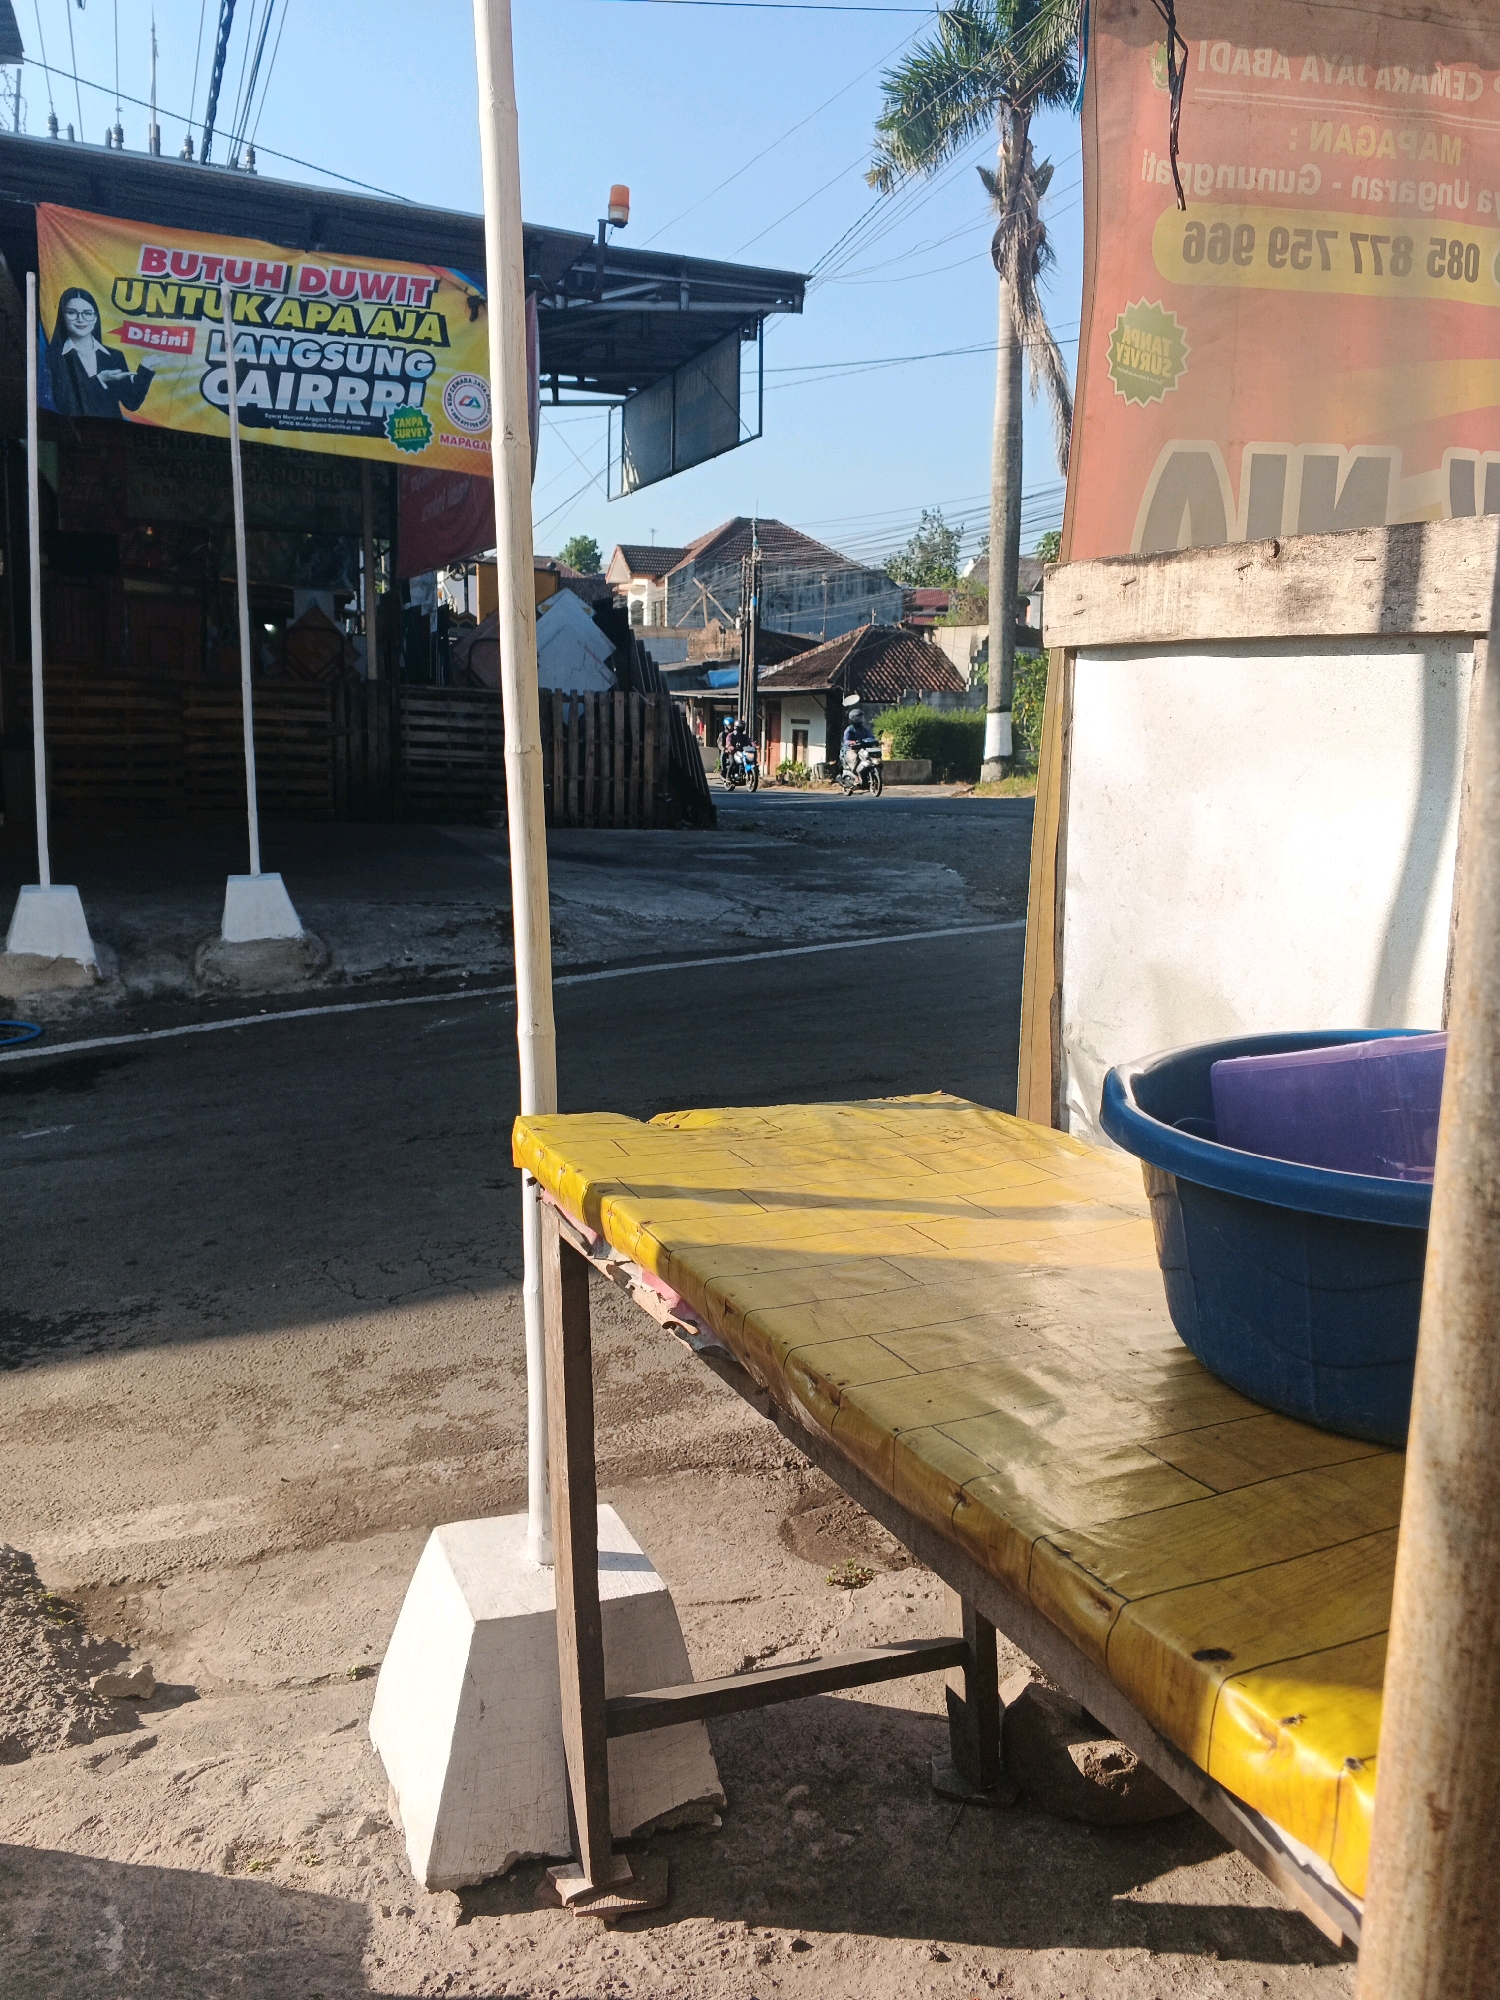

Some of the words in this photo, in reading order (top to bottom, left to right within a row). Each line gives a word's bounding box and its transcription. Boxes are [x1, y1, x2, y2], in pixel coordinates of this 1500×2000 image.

[139, 246, 286, 290] BUTUH
[298, 265, 432, 304] DUWIT
[113, 278, 264, 324] UNTUK
[272, 298, 358, 334] APA
[366, 309, 444, 343] AJA
[127, 326, 189, 347] Disini
[208, 331, 434, 379] LANGSUNG
[394, 417, 424, 428] TANPA
[394, 427, 427, 439] SURVEY
